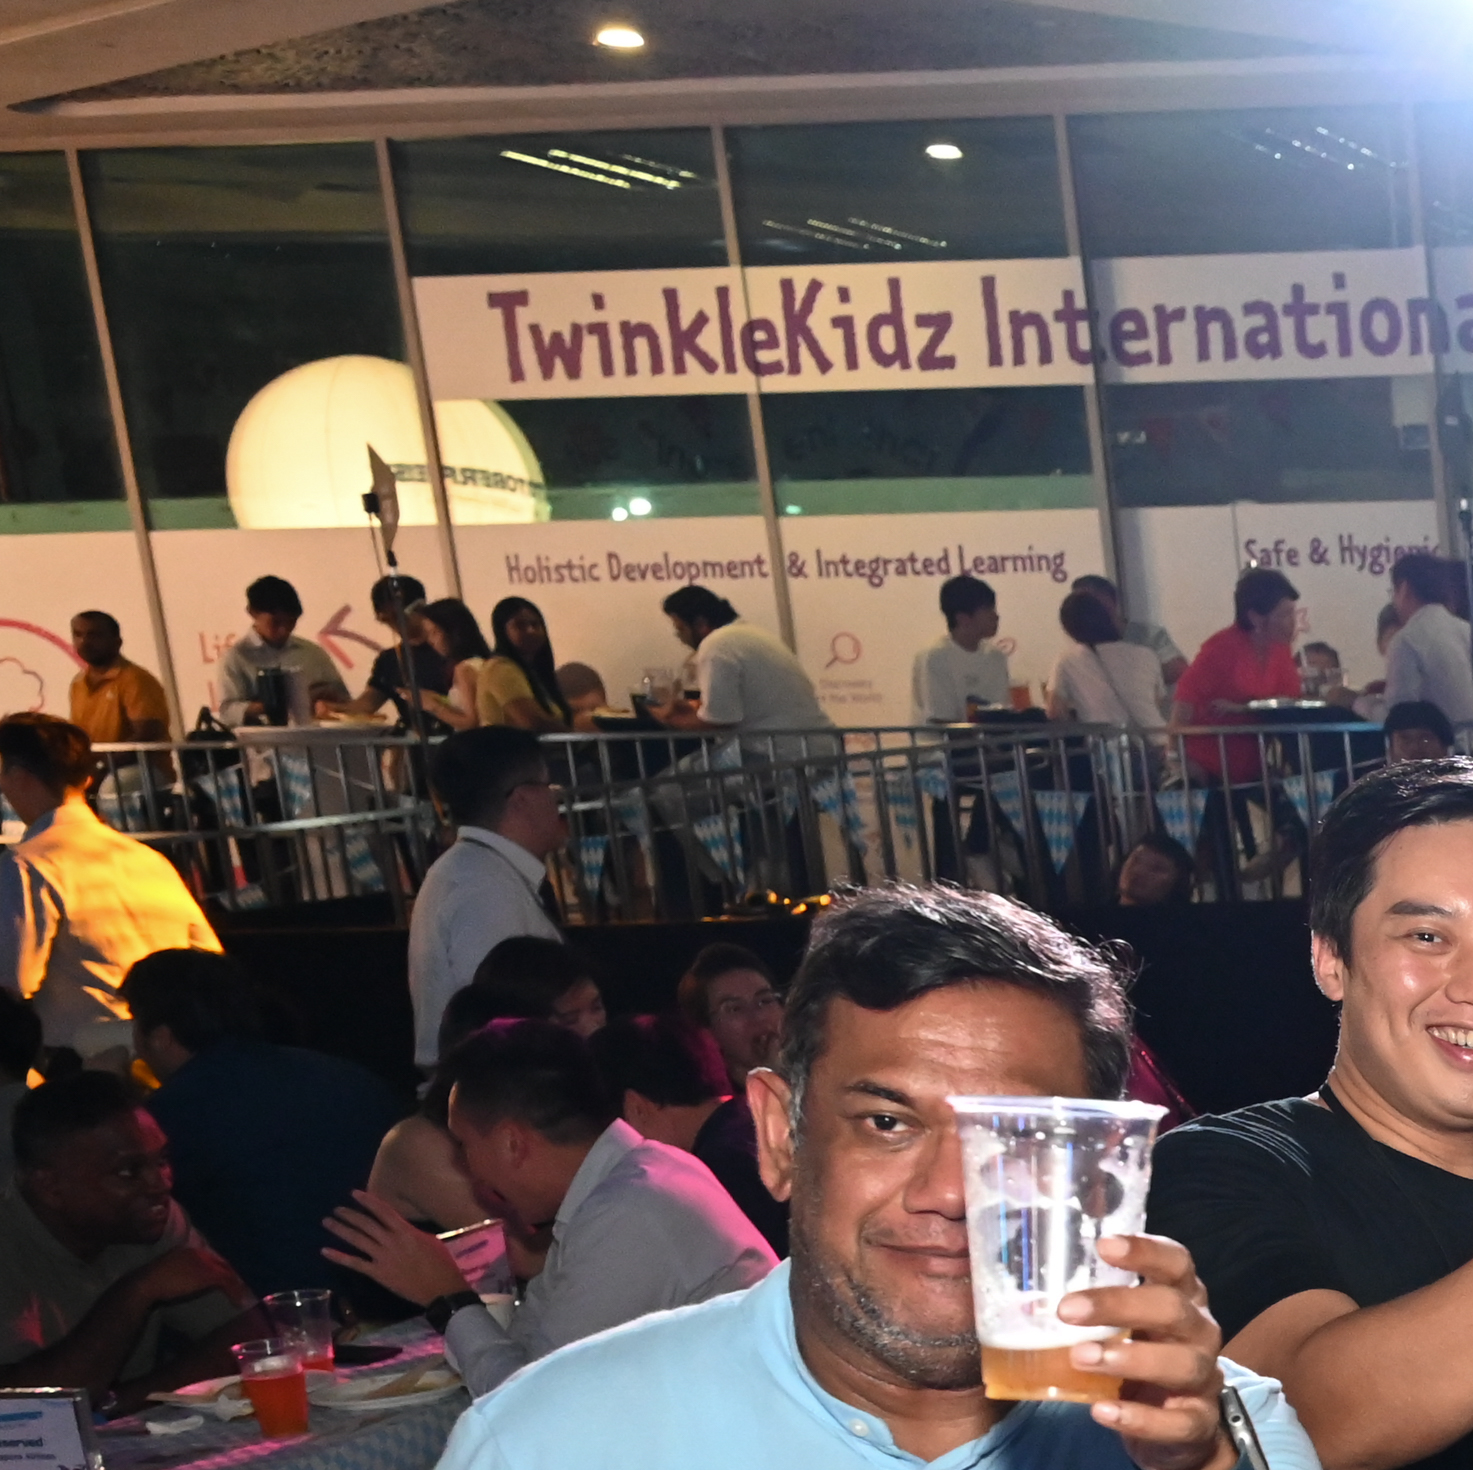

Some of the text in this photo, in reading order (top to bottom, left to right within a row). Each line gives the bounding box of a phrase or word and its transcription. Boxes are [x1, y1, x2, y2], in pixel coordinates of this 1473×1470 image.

[487, 276, 957, 384] TwinkleKidz
[506, 545, 1067, 588] Holistic Development & Integrated Learning
[1244, 536, 1299, 567] Safe
[1310, 536, 1330, 566] &
